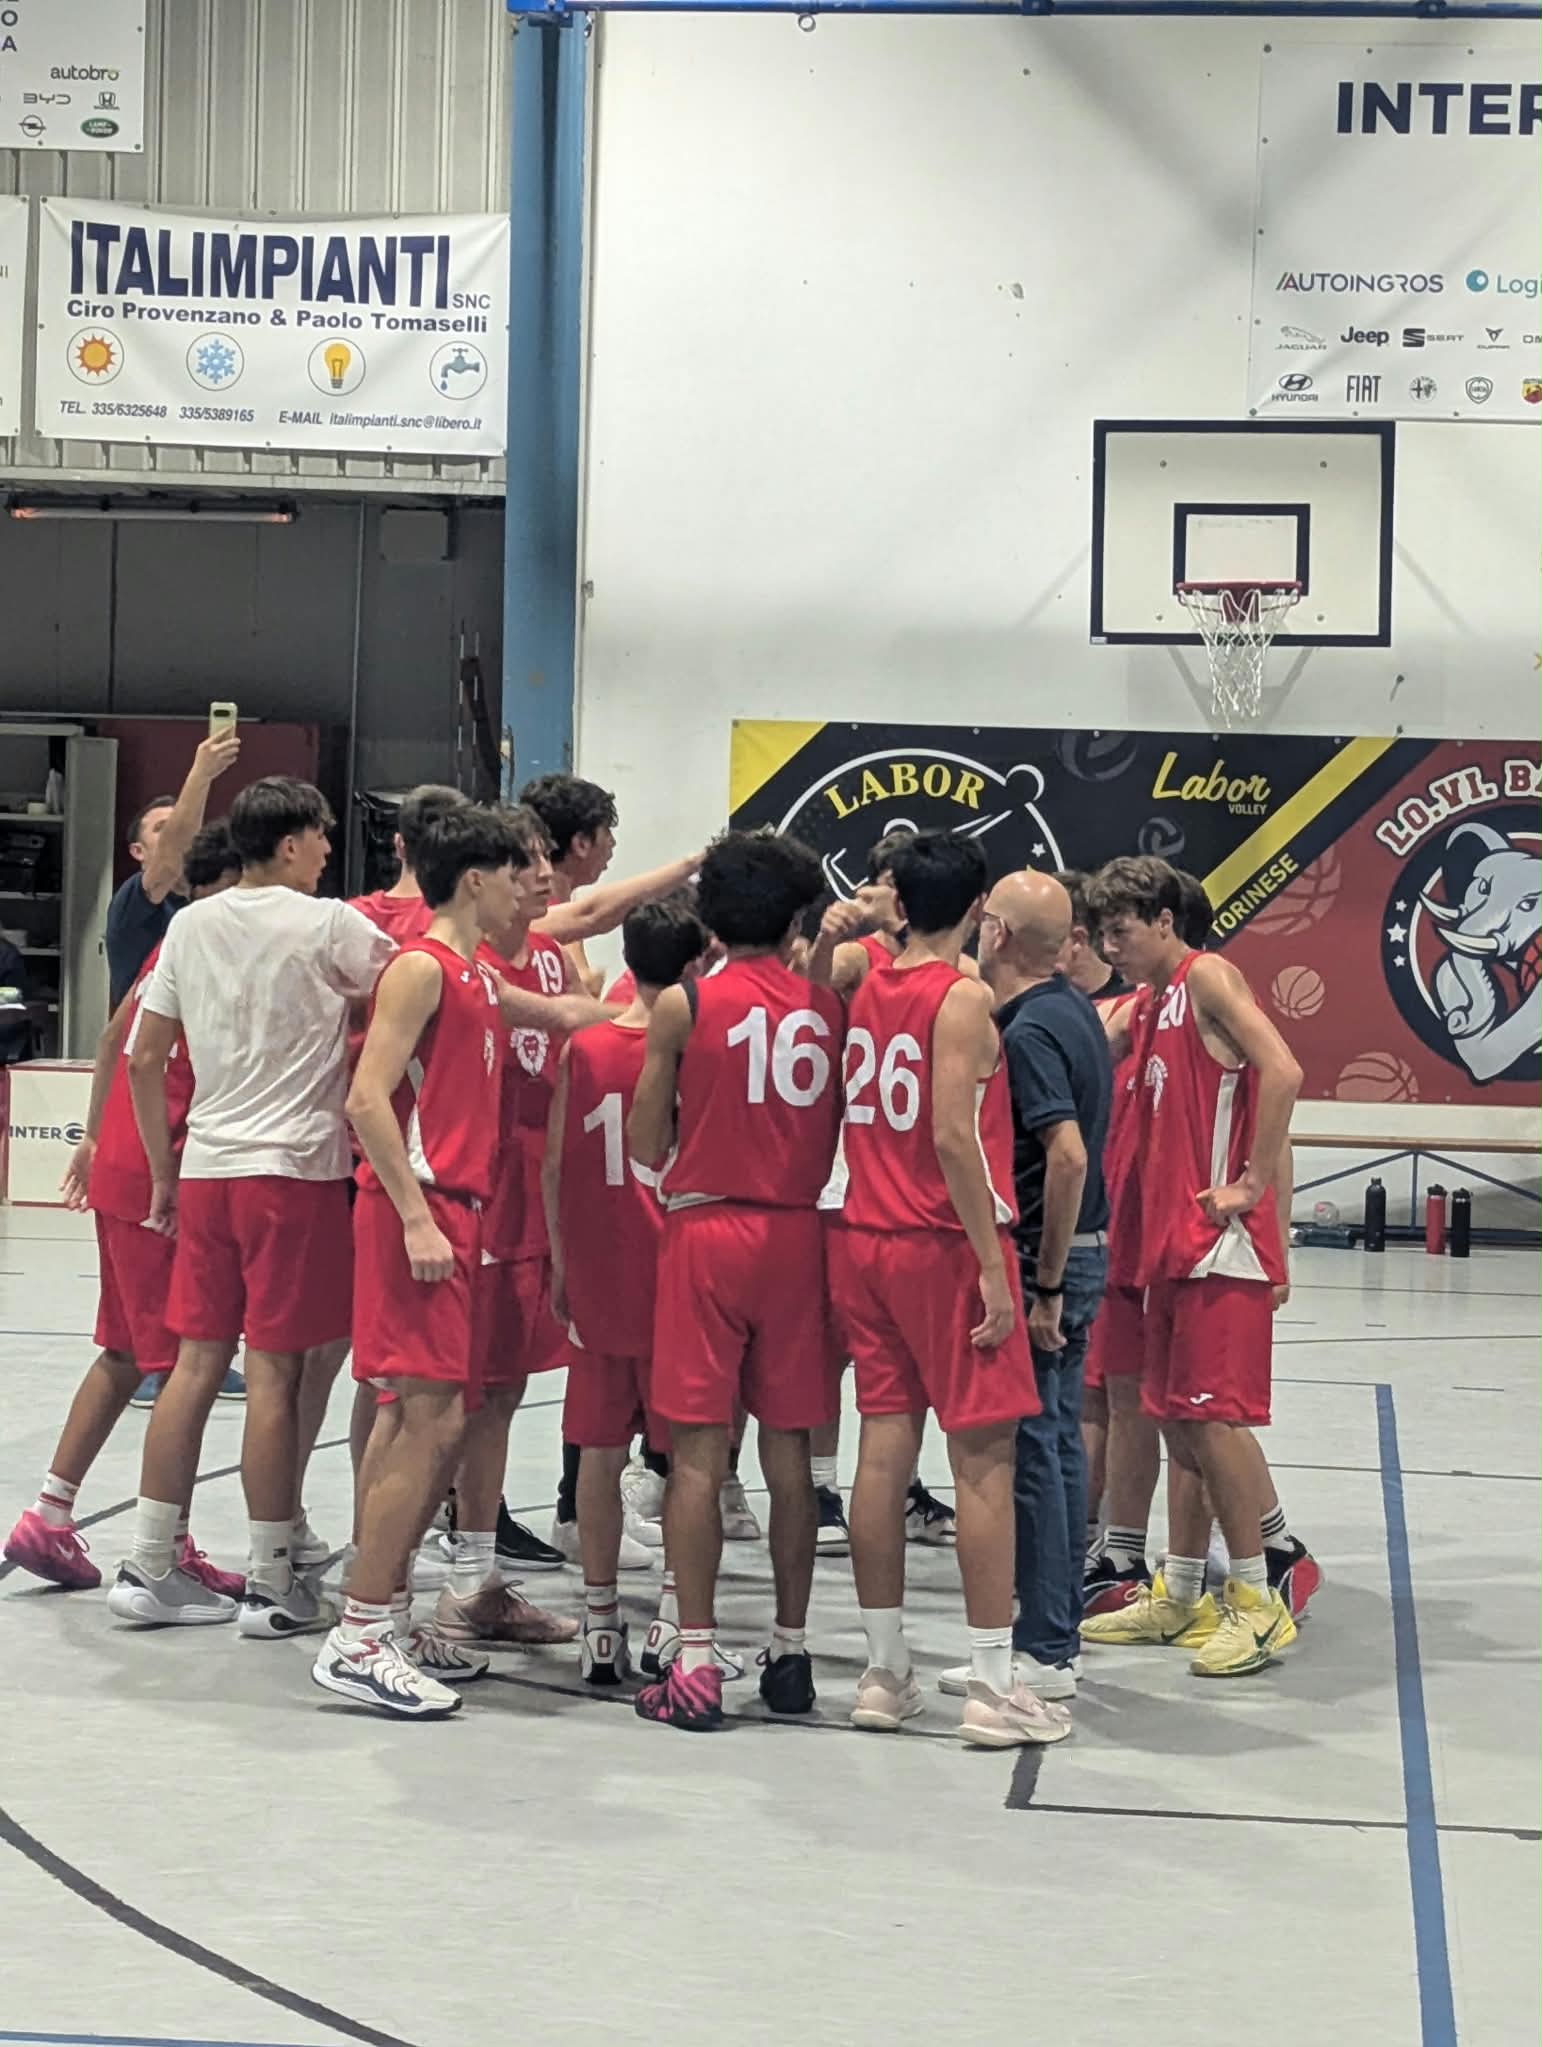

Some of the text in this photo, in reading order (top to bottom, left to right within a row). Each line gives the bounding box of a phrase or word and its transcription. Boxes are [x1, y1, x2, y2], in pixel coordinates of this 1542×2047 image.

[23, 92, 71, 105] BYD
[71, 220, 491, 309] ITALIMPIANTI SNC
[1276, 272, 1444, 293] AUTOINGROS
[67, 300, 487, 333] Ciro Provenzano & Paolo Tomaselli
[1340, 326, 1390, 347] Jeep
[1346, 375, 1382, 402] FIAT
[92, 402, 168, 418] 335/6325648
[179, 406, 255, 422] 335/5389165
[278, 411, 323, 425] E-MAIL
[824, 763, 985, 819] LABOR
[1152, 752, 1271, 802] Labor
[1505, 760, 1542, 798] B
[1228, 803, 1268, 815] VOLLEY
[1211, 852, 1300, 938] TORINESE
[531, 950, 563, 994] 19
[1157, 981, 1187, 1030] 20
[727, 1006, 830, 1107] 16
[842, 1027, 922, 1132] 26
